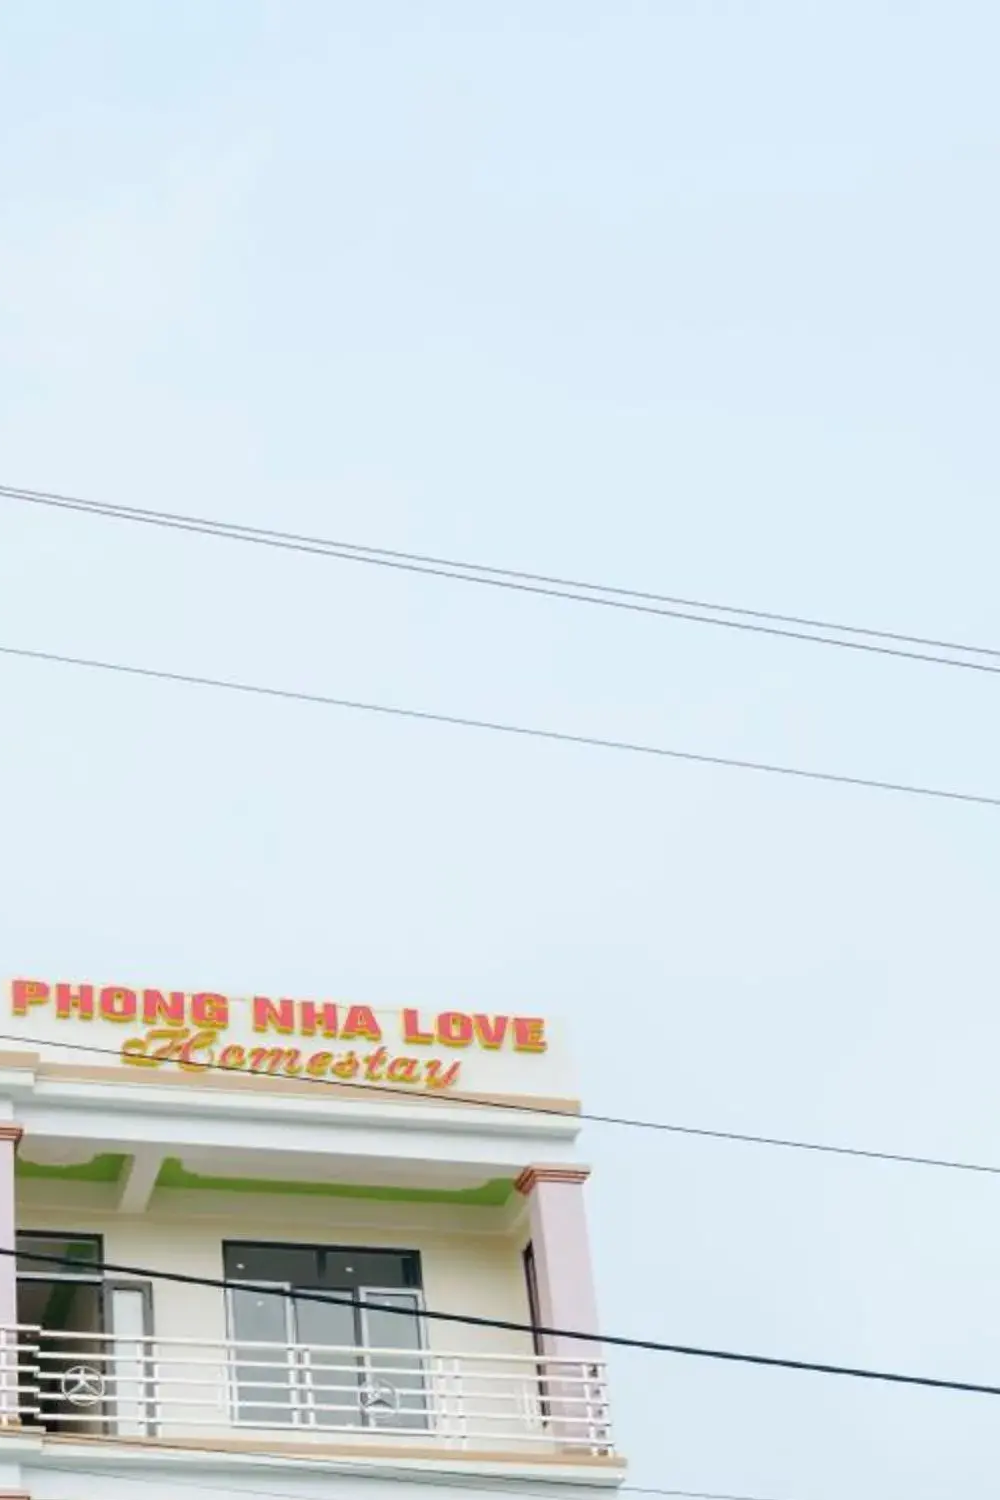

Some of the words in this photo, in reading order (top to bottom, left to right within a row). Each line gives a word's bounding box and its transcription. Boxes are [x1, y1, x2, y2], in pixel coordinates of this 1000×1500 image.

[10, 977, 229, 1028] PHONG
[253, 995, 382, 1042] NHA
[403, 1007, 547, 1053] LOVE
[120, 1027, 462, 1089] Homestay
